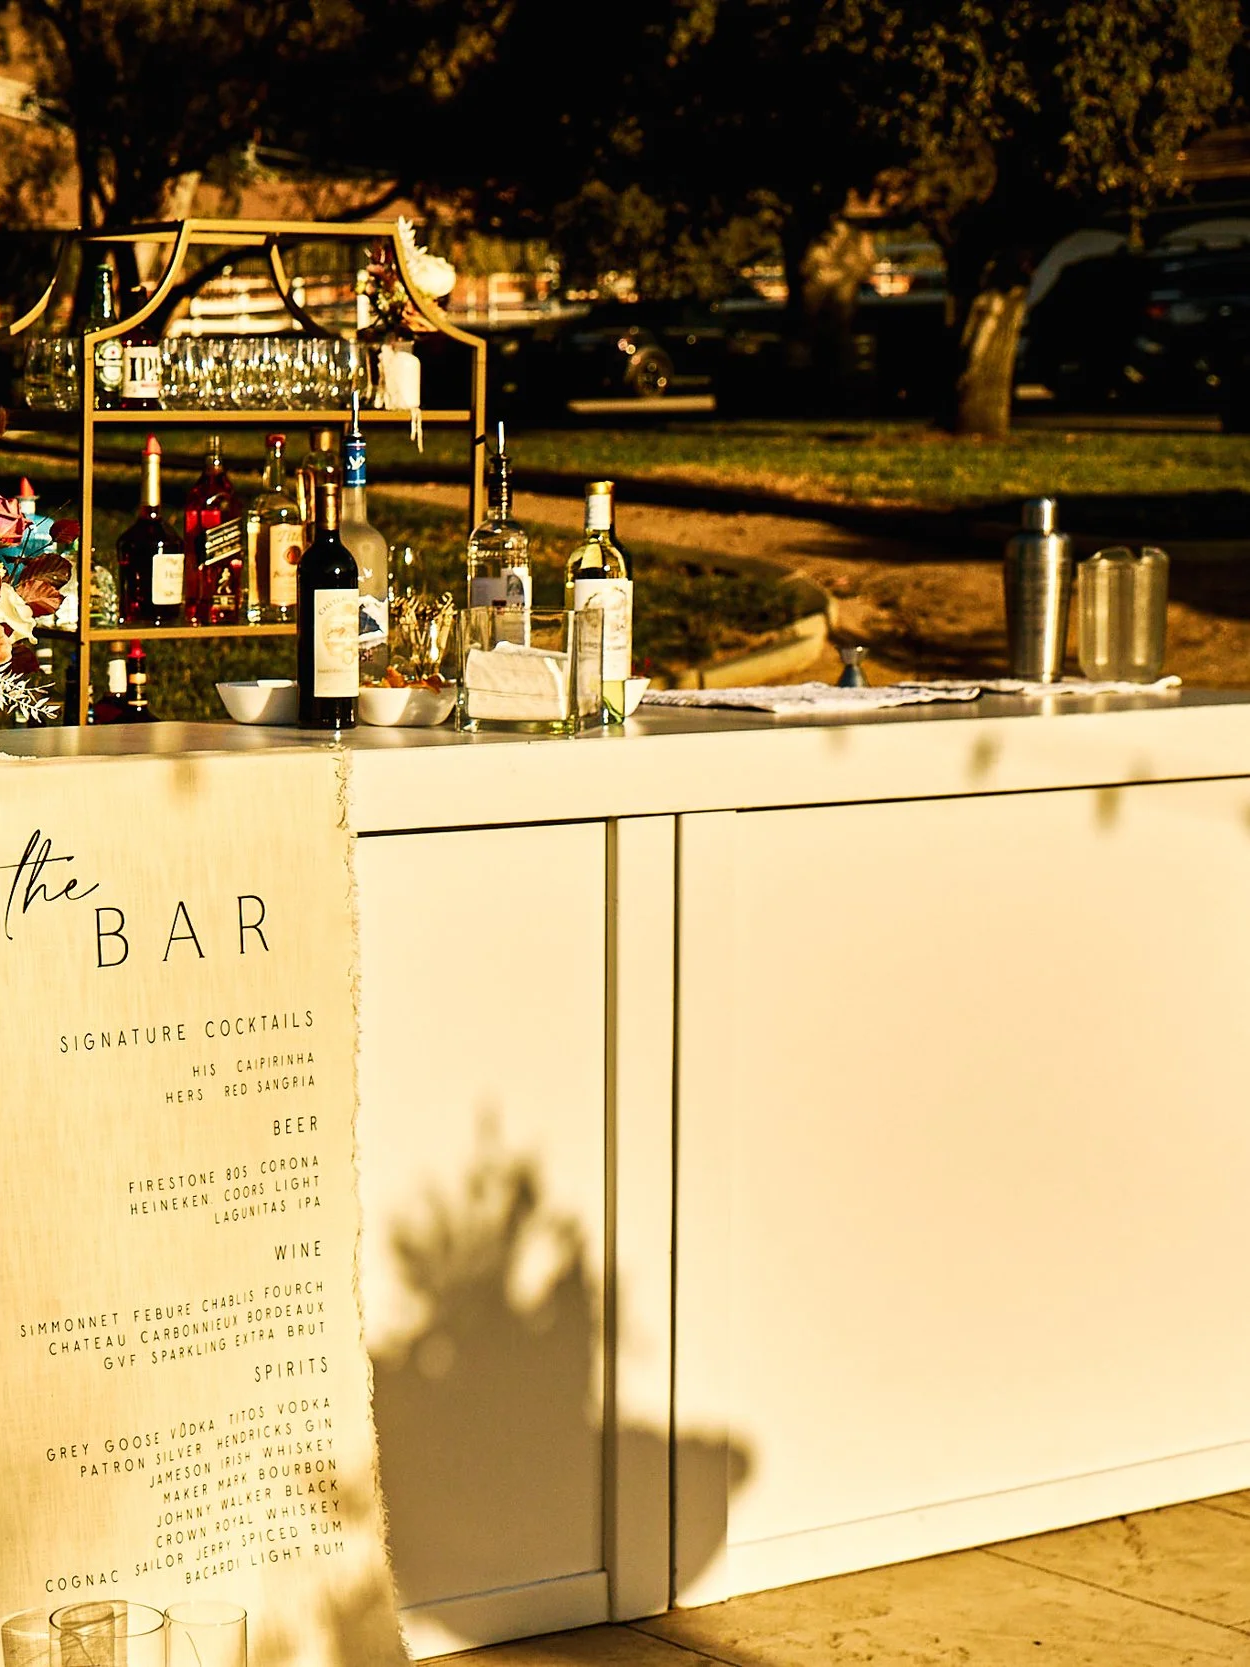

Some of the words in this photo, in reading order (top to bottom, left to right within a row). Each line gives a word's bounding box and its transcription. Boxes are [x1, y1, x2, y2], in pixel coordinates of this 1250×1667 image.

[95, 895, 269, 968] BAR
[60, 1024, 186, 1053] SIGNATURE
[205, 1010, 313, 1038] COCKTAILS
[193, 1063, 216, 1078] HIS
[237, 1052, 314, 1073] CAIPIRINHA
[166, 1088, 203, 1103] HERS
[225, 1082, 247, 1097] RED
[257, 1075, 315, 1093] SANGRIA
[274, 1116, 318, 1136] BEER
[129, 1171, 215, 1194] FIRESTONE
[226, 1166, 248, 1181] 805
[261, 1156, 319, 1174] CORONA
[224, 1183, 264, 1201] COORS
[275, 1176, 319, 1192] LIGHT
[215, 1200, 286, 1224] LAGUNITAS
[299, 1197, 320, 1209] IPA
[275, 1241, 321, 1261] WINE
[21, 1313, 118, 1337] SIMMONNET
[202, 1291, 254, 1312] CHABLIS
[264, 1282, 323, 1299] FOURCH
[49, 1335, 126, 1356] CHATEAU
[141, 1315, 238, 1343] CARBONNIEUX
[247, 1302, 324, 1323] BORDEAUX
[104, 1355, 136, 1370] GVF
[152, 1338, 226, 1364] SPARKLING
[235, 1328, 274, 1347] EXTRA
[288, 1322, 325, 1337] BRUT
[255, 1357, 328, 1382] SPIRITS
[47, 1443, 88, 1461] GREY
[105, 1432, 159, 1453] GOOSE
[171, 1420, 214, 1440] VODKA
[230, 1406, 264, 1424] TITOS
[278, 1398, 330, 1415] VODKA
[81, 1458, 145, 1478] PATRON
[156, 1444, 201, 1465] SILVER
[217, 1423, 292, 1449] HENDRICKS
[306, 1418, 332, 1432] GIN
[150, 1463, 210, 1488] JAMESON
[221, 1453, 251, 1469] IRISH
[263, 1439, 333, 1458] WHISKEY
[164, 1484, 208, 1504] MAKER
[218, 1473, 247, 1491] MARK
[259, 1460, 336, 1480] BOURBON
[157, 1505, 211, 1528] JOHNNY
[221, 1488, 271, 1510] WALKER
[286, 1480, 338, 1497] BLACK
[157, 1527, 206, 1548] CROWN
[216, 1513, 252, 1531] ROYAL
[266, 1500, 339, 1520] WHISKEY
[46, 1570, 118, 1593] COGNAC
[135, 1553, 184, 1576] SAILOR
[196, 1540, 231, 1561] JERRY
[242, 1526, 298, 1547] SPICED
[311, 1520, 342, 1534] RUM
[186, 1560, 240, 1584] BACARDI
[251, 1547, 301, 1566] LIGHT
[315, 1541, 344, 1556] RUM
